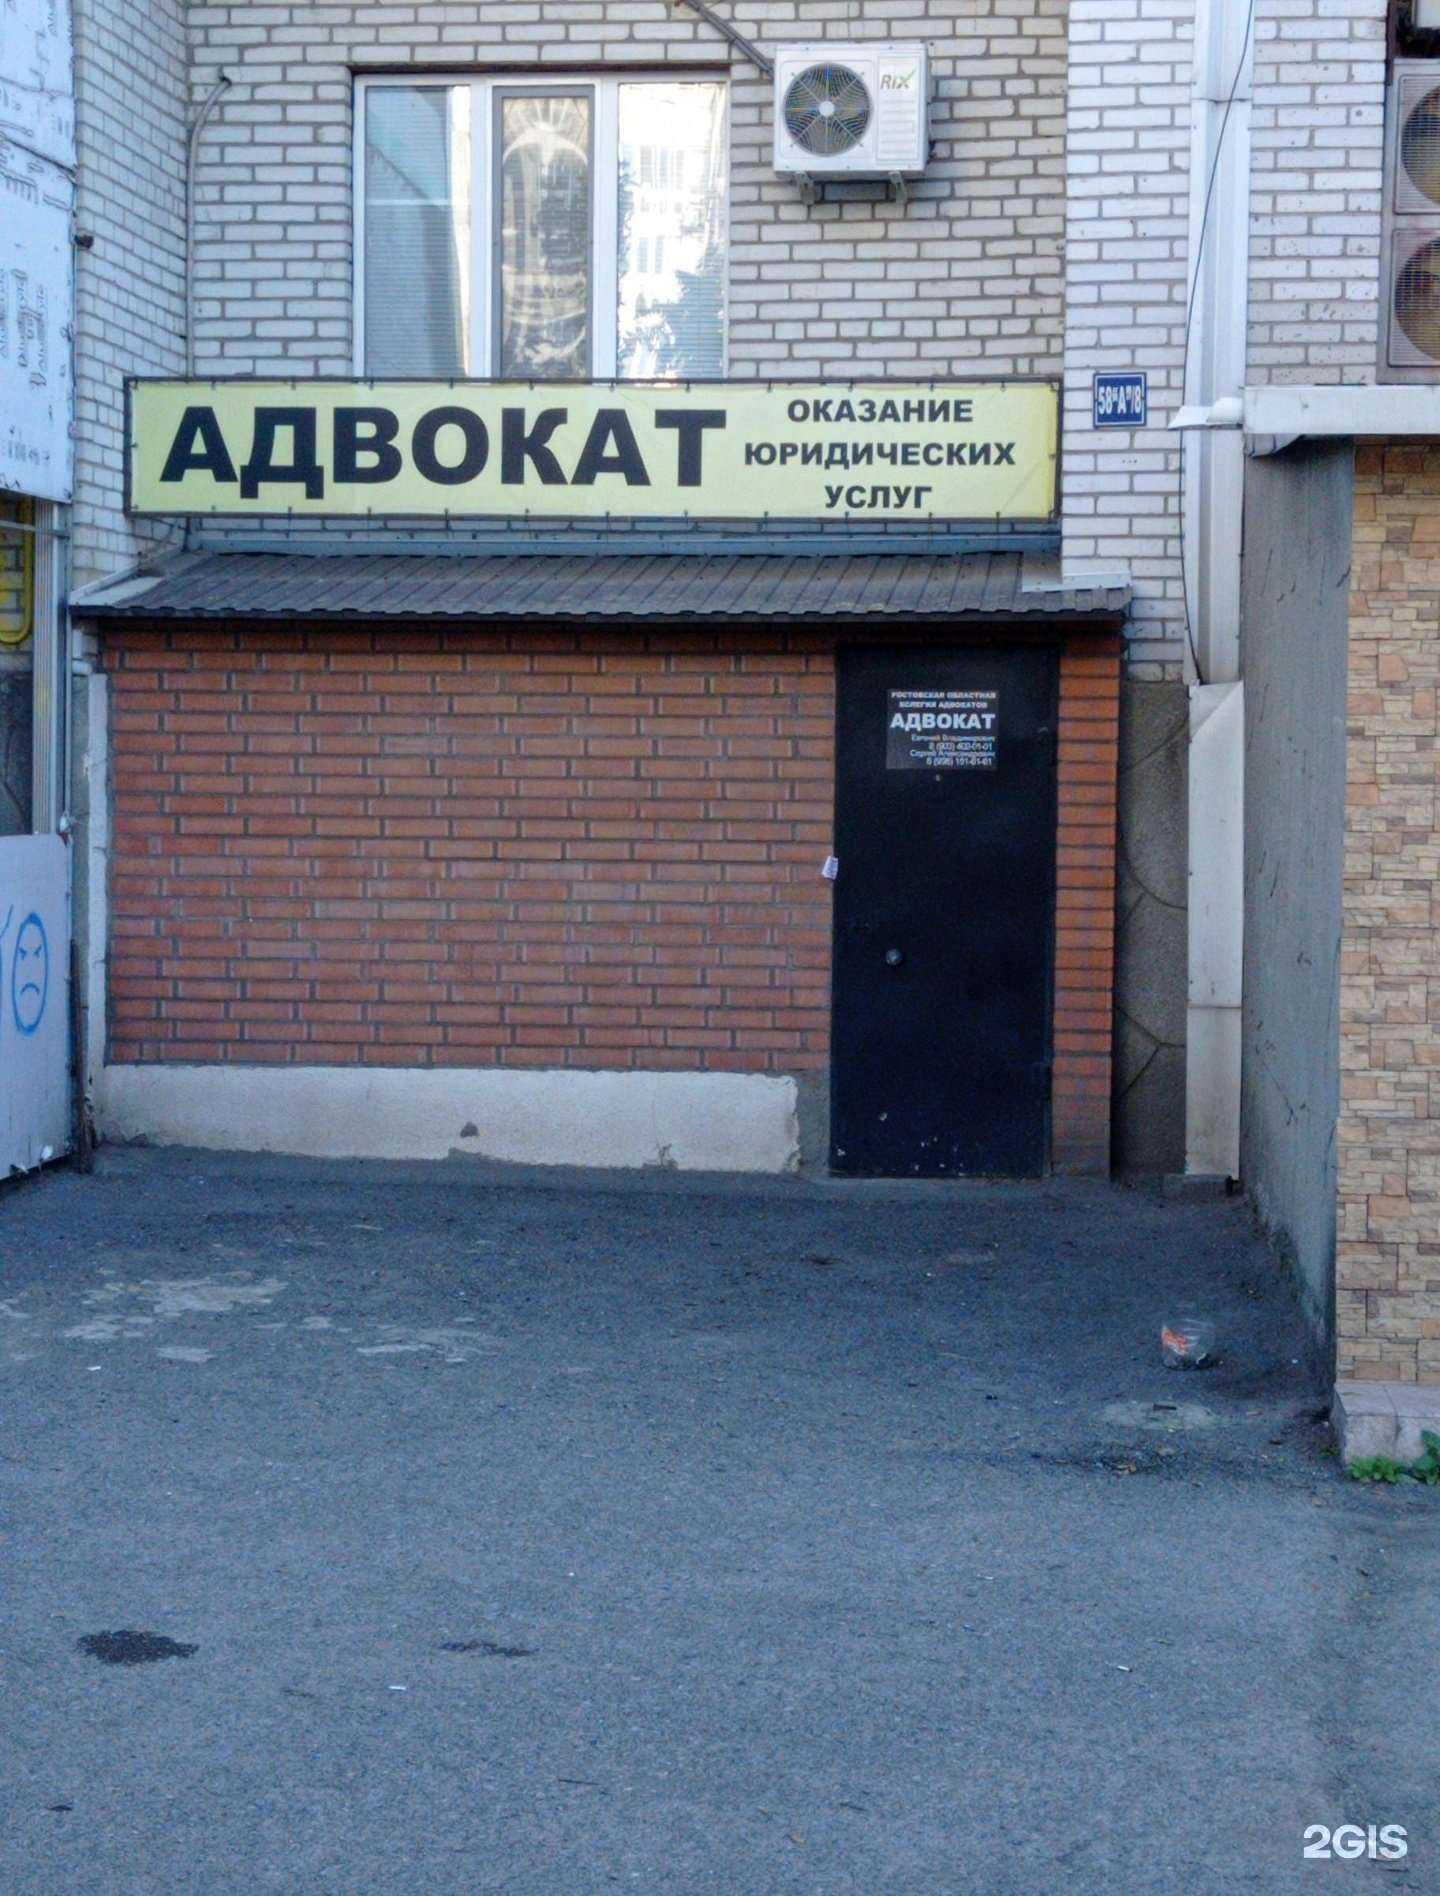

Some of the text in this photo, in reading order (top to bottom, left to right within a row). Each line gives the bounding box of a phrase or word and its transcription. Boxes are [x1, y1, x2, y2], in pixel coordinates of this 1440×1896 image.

[787, 399, 974, 423] ОКАЗАНИЕ
[159, 405, 727, 499] АДВОКАТ
[744, 442, 1017, 470] ЮРИДИЧЕСКИХ
[824, 485, 933, 509] УСЛУГ
[890, 713, 995, 731] АДВОКАТ
